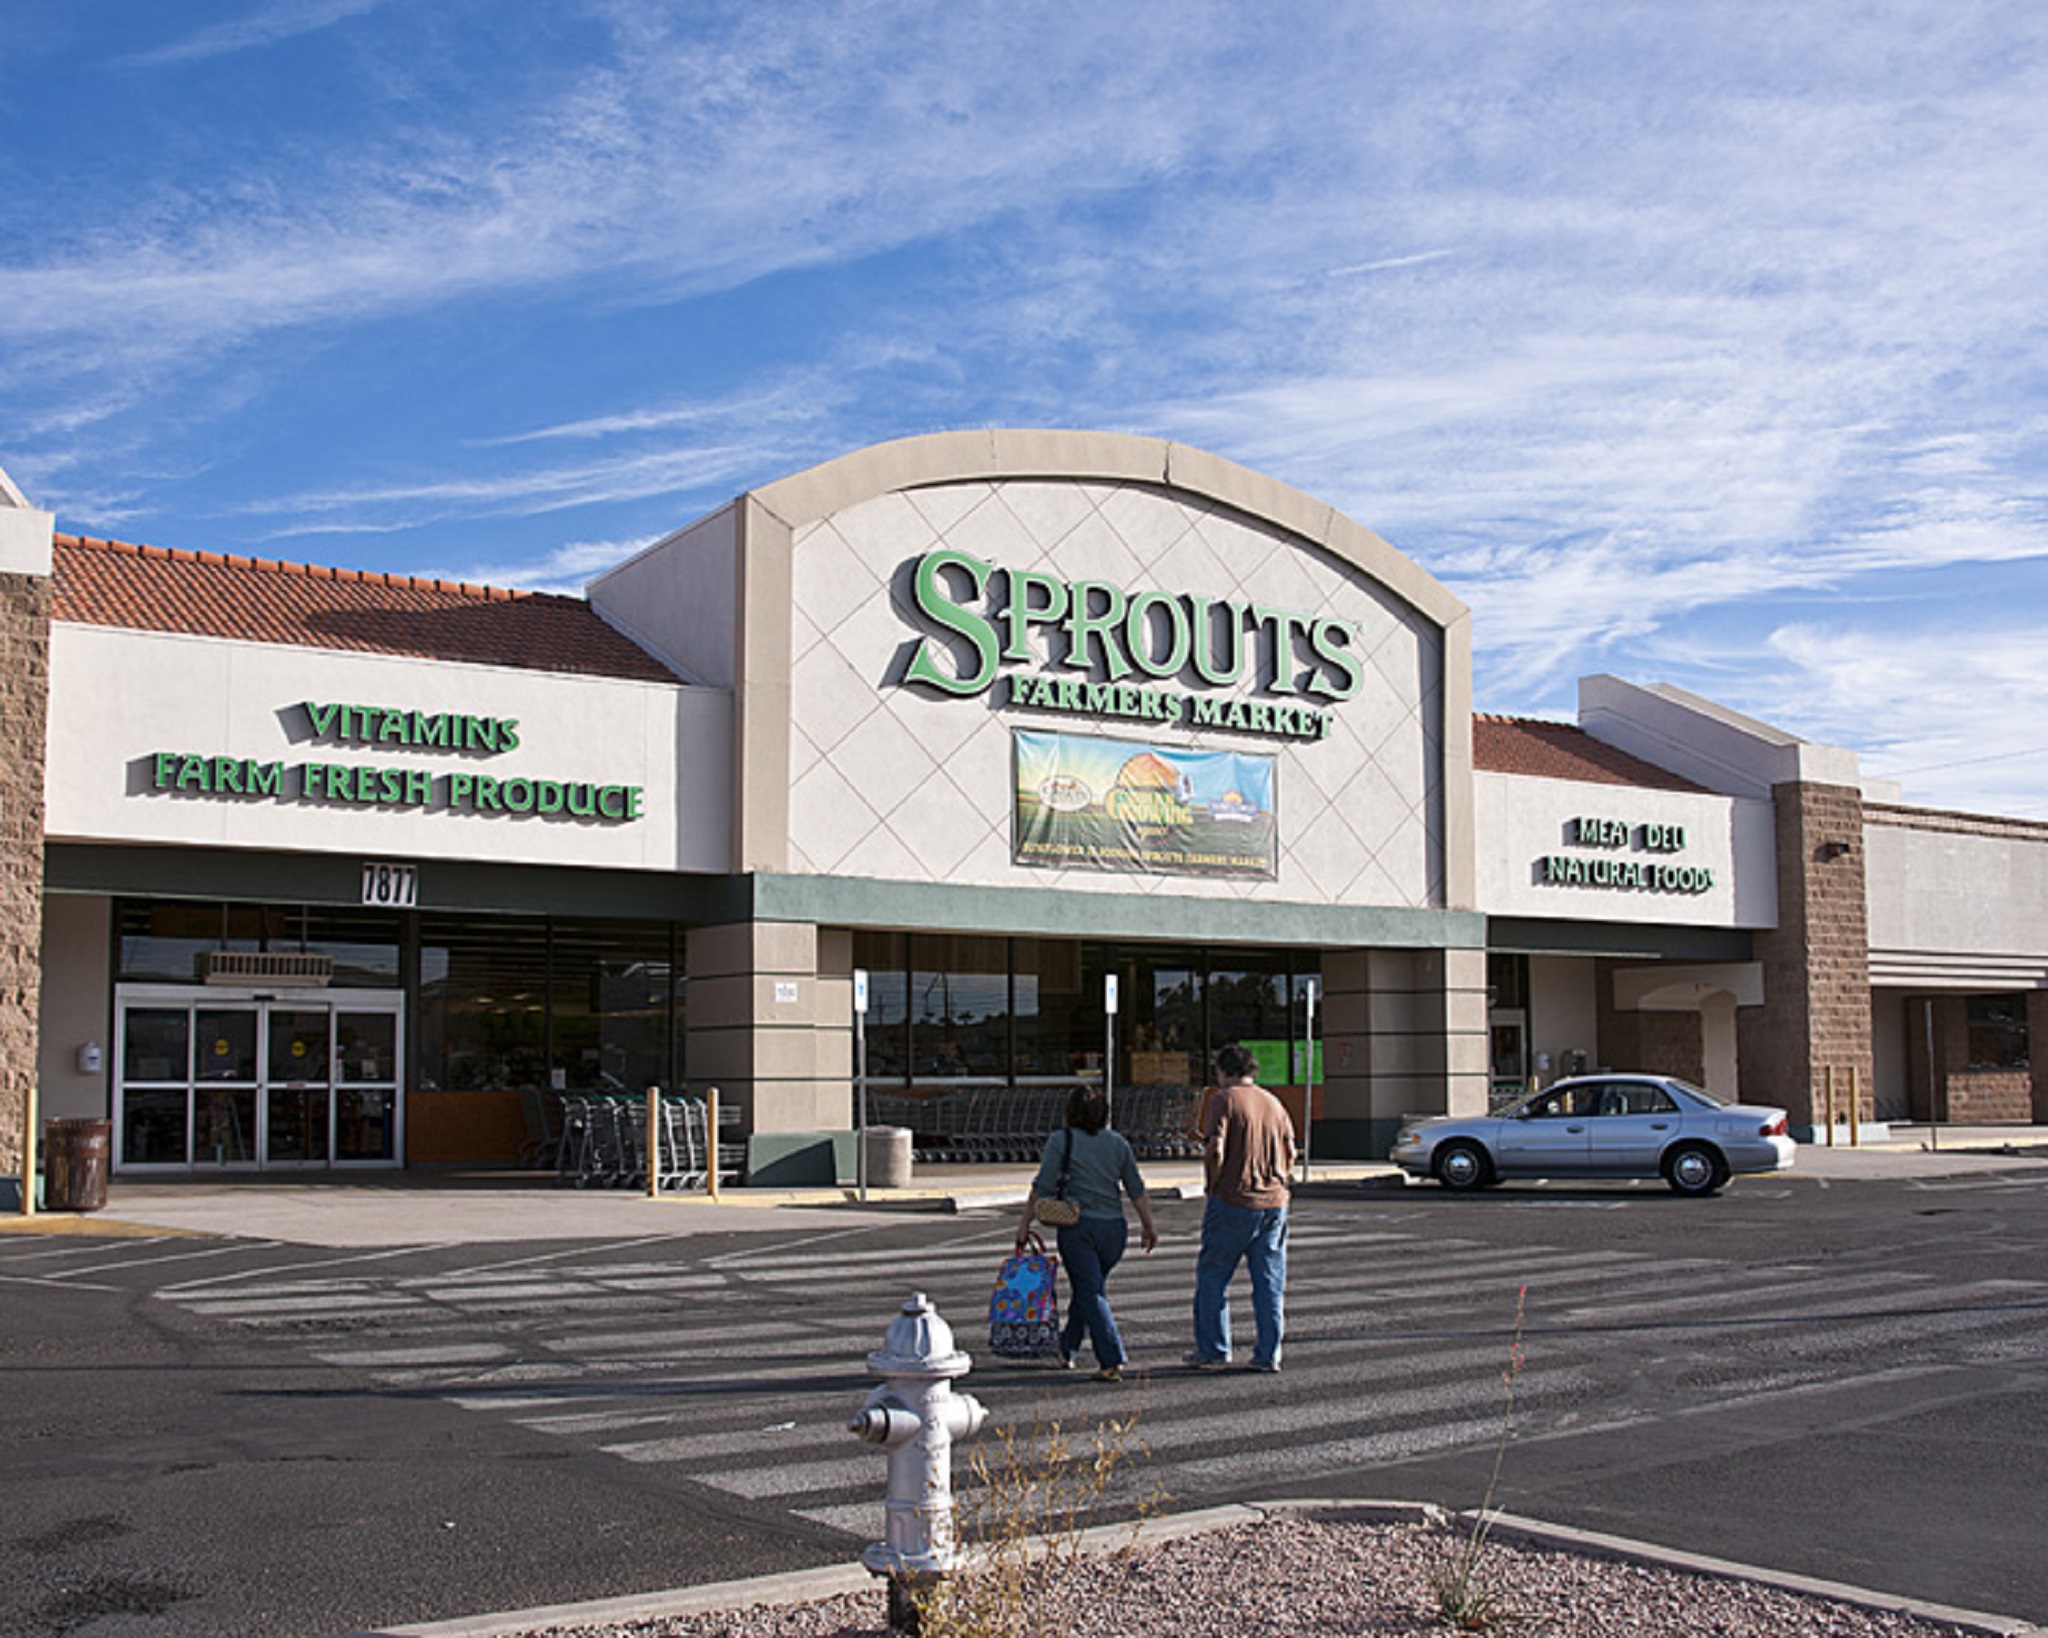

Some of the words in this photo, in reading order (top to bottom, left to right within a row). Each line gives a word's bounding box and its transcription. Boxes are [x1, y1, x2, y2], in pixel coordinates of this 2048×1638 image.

[906, 549, 1364, 699] SPROUTS
[303, 701, 520, 753] VITAMINS
[1010, 674, 1184, 723] FARMERS
[1192, 697, 1336, 740] MARKET
[154, 752, 285, 795] FARM
[303, 763, 433, 806] FRESH
[450, 774, 645, 819] PRODUCE
[364, 864, 416, 905] 7877
[1548, 856, 1648, 887] NATURAL
